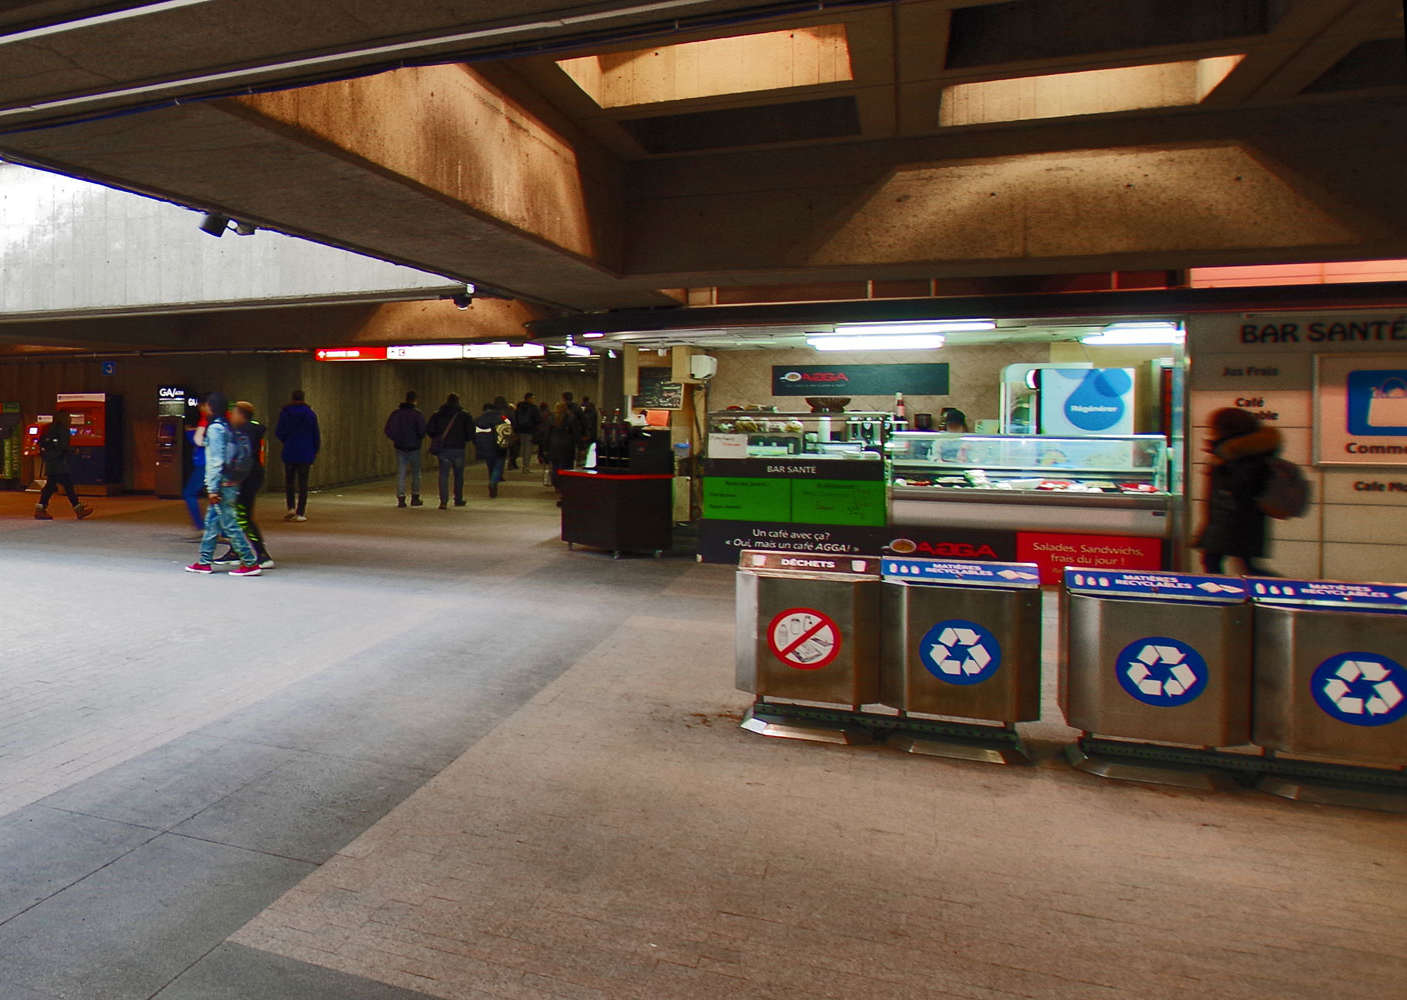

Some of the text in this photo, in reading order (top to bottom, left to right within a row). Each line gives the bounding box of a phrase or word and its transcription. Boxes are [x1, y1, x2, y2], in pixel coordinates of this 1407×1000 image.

[1240, 316, 1407, 343] BAR SANTÉ
[1223, 366, 1279, 376] Jus Frais
[801, 372, 849, 382] AGGA
[1235, 397, 1265, 407] Café
[767, 465, 785, 473] BAR
[752, 529, 831, 541] Un café avec ça?
[733, 539, 752, 548] Oui,
[754, 540, 776, 548] mais
[793, 541, 812, 550] café
[815, 543, 851, 552] AGGA!
[918, 541, 998, 558] AGGA
[1032, 542, 1144, 556] Salades, Sandwichs,
[781, 558, 836, 568] DÉCHETS
[1050, 554, 1074, 563] frais
[1077, 555, 1092, 564] du
[1094, 555, 1117, 566] jour
[925, 567, 994, 576] RECYCLABLES
[932, 563, 982, 571] MATIÈRES
[1115, 578, 1193, 589] RECYCLABLES
[1122, 574, 1179, 583] MATIÈRES
[1308, 583, 1373, 592] MATIÈRES
[1300, 588, 1390, 598] RECYCLABLES
